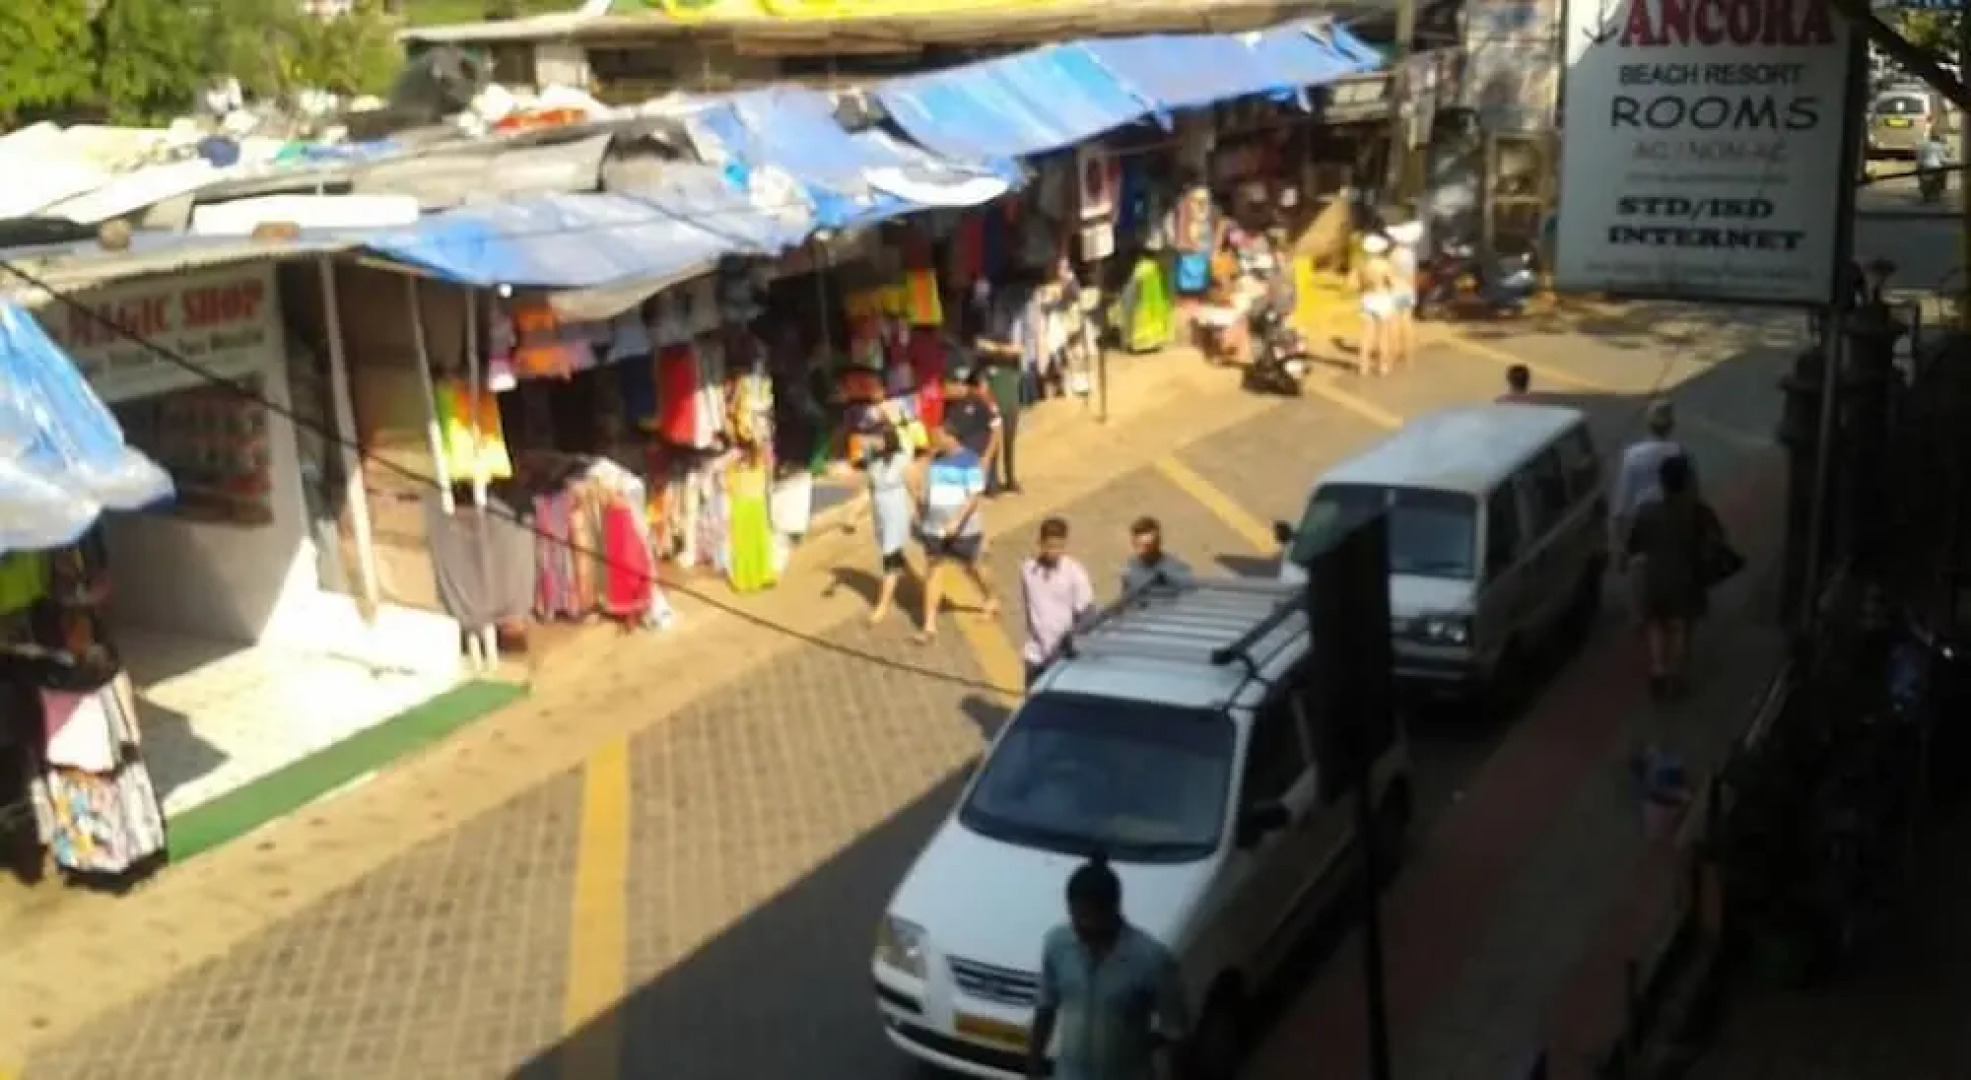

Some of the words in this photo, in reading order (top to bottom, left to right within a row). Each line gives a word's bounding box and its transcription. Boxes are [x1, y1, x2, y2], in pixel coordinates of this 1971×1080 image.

[1620, 0, 1835, 46] ANCORA
[1620, 63, 1698, 85] BEACH
[1705, 63, 1804, 86] RESORT
[1611, 95, 1820, 131] ROOMS
[1617, 195, 1776, 221] STD/ISD
[1608, 225, 1807, 249] INTERNET
[182, 279, 263, 326] SHOP
